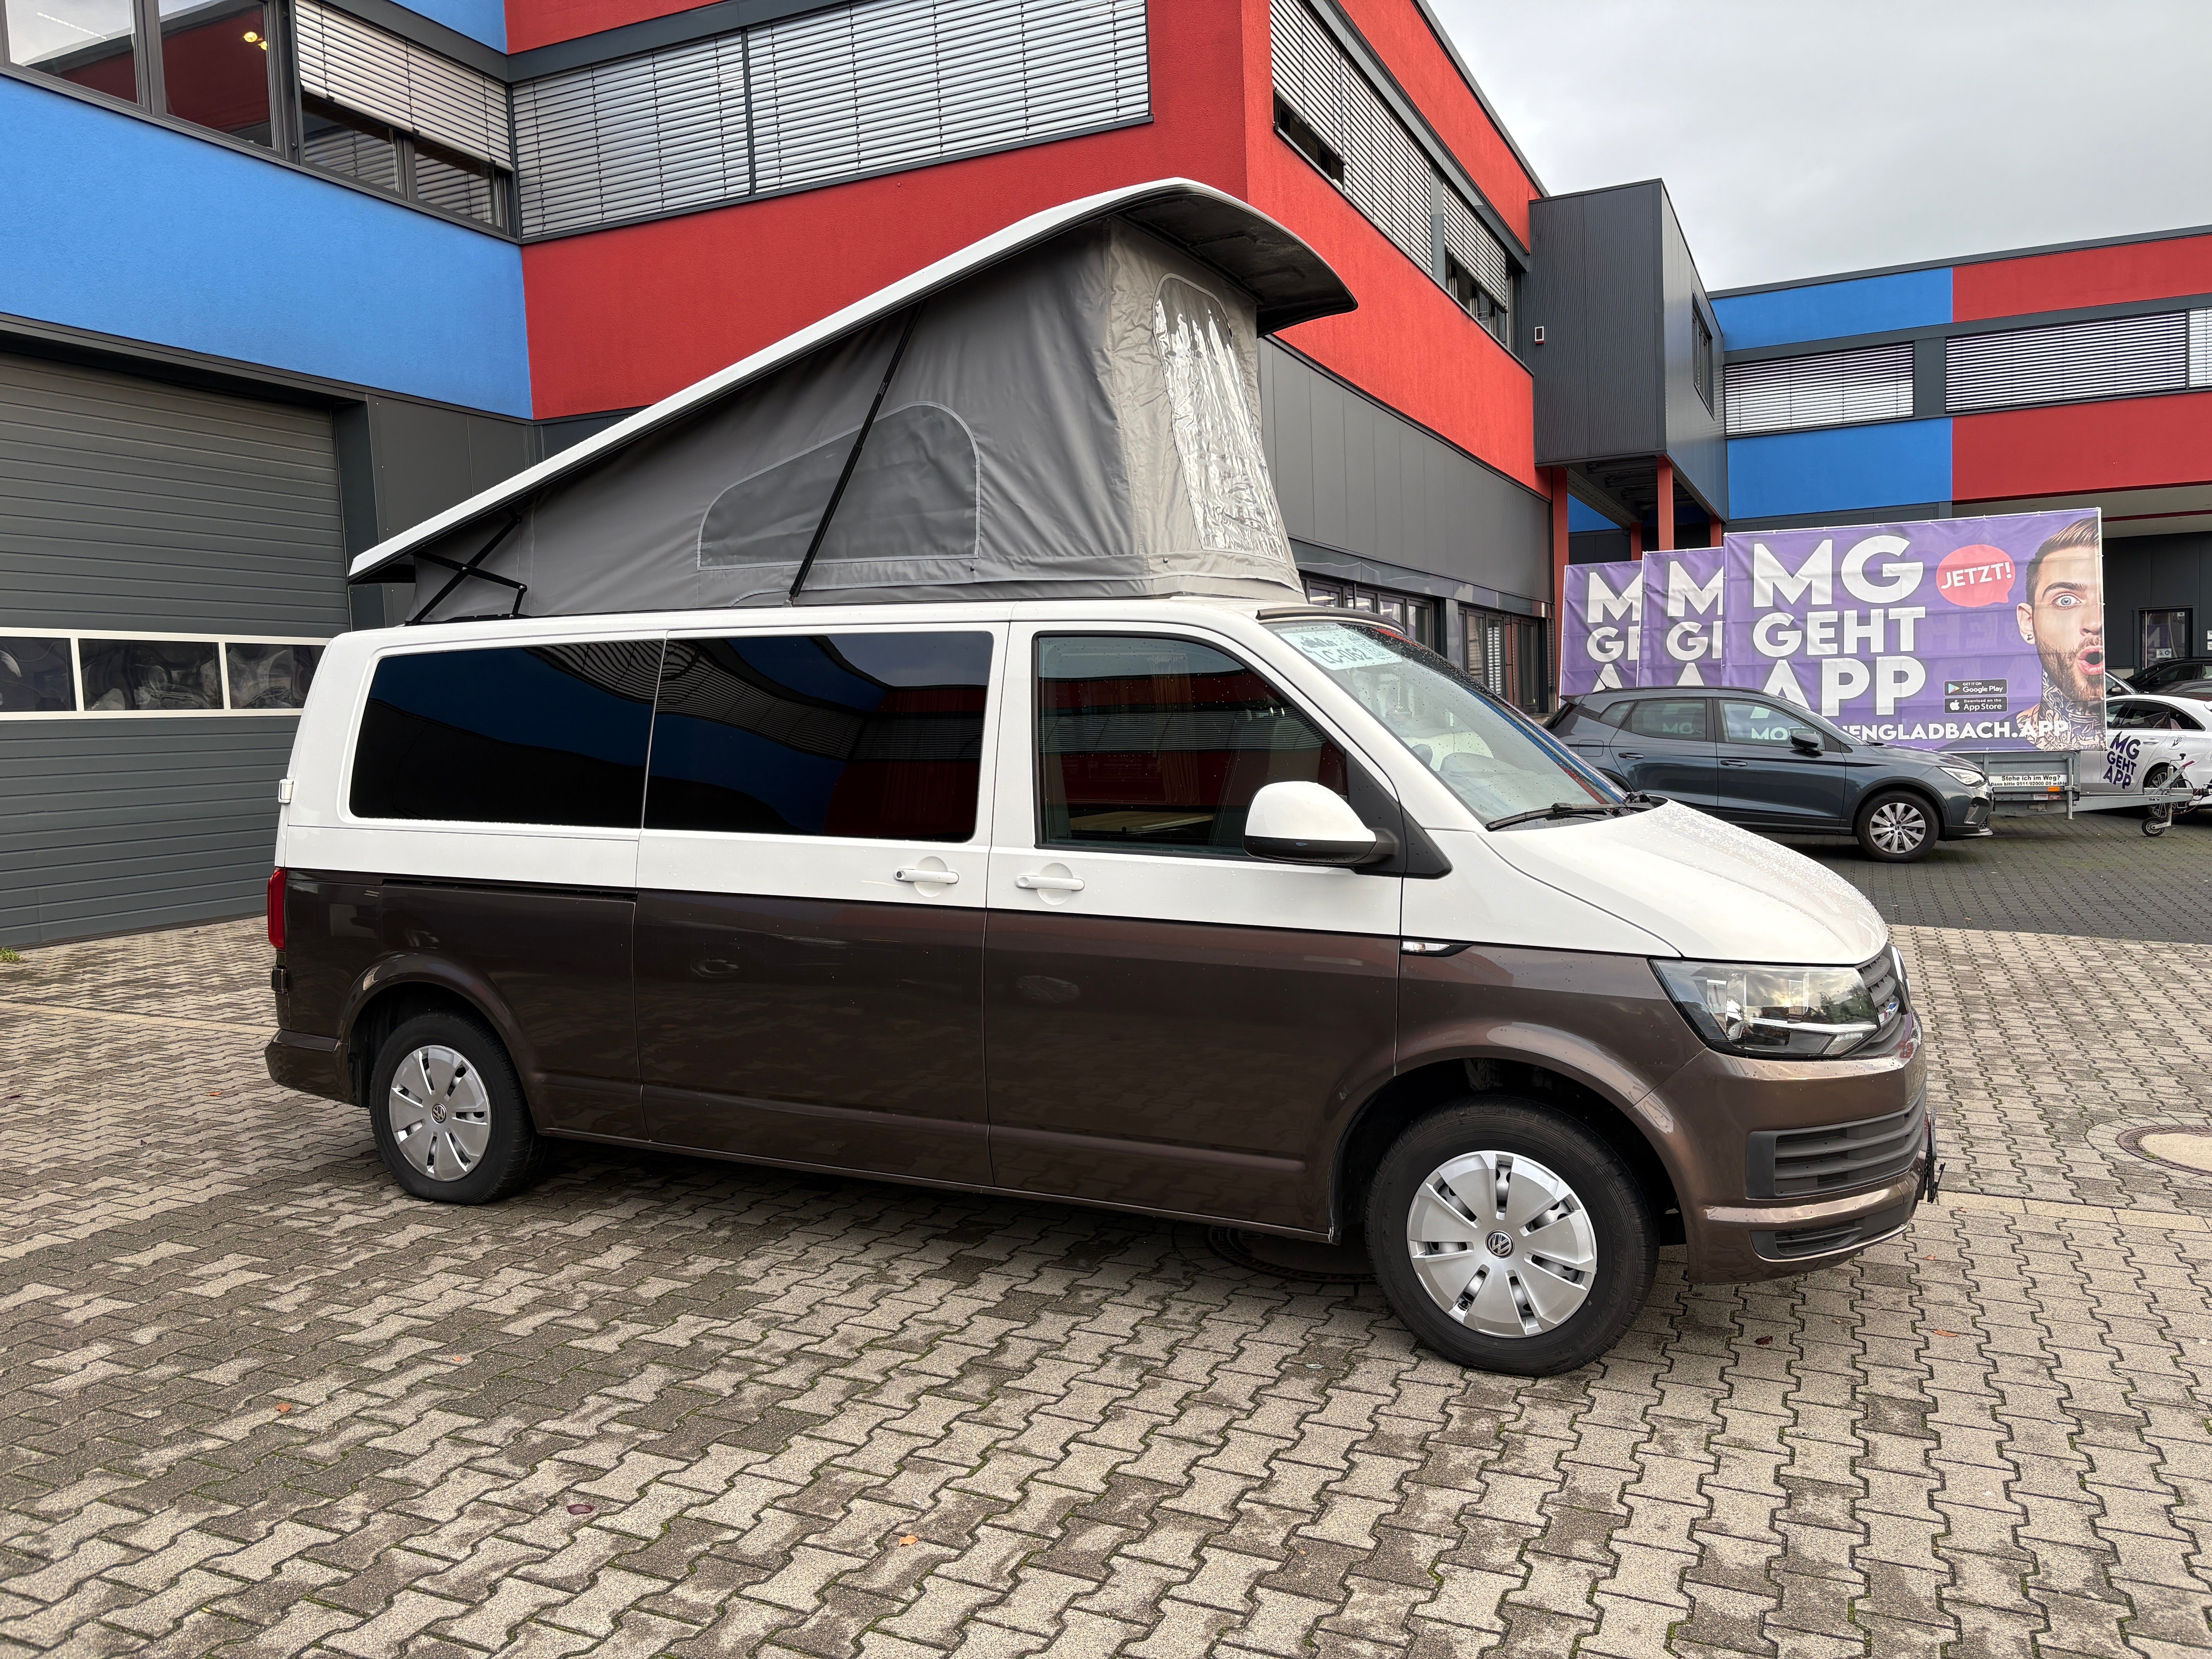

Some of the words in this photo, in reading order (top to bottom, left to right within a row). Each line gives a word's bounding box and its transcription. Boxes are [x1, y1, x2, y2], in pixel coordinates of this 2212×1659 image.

[1668, 561, 1723, 617] M
[1753, 535, 1924, 608] MG
[1941, 562, 2013, 590] JETZT!
[1587, 572, 1642, 623] M
[1753, 606, 1926, 658] GEHT
[1313, 647, 1373, 663] LC-062
[1754, 655, 1926, 718] APP
[2107, 751, 2137, 776] GEHT
[2110, 731, 2141, 759] MG
[2103, 765, 2131, 789] APP
